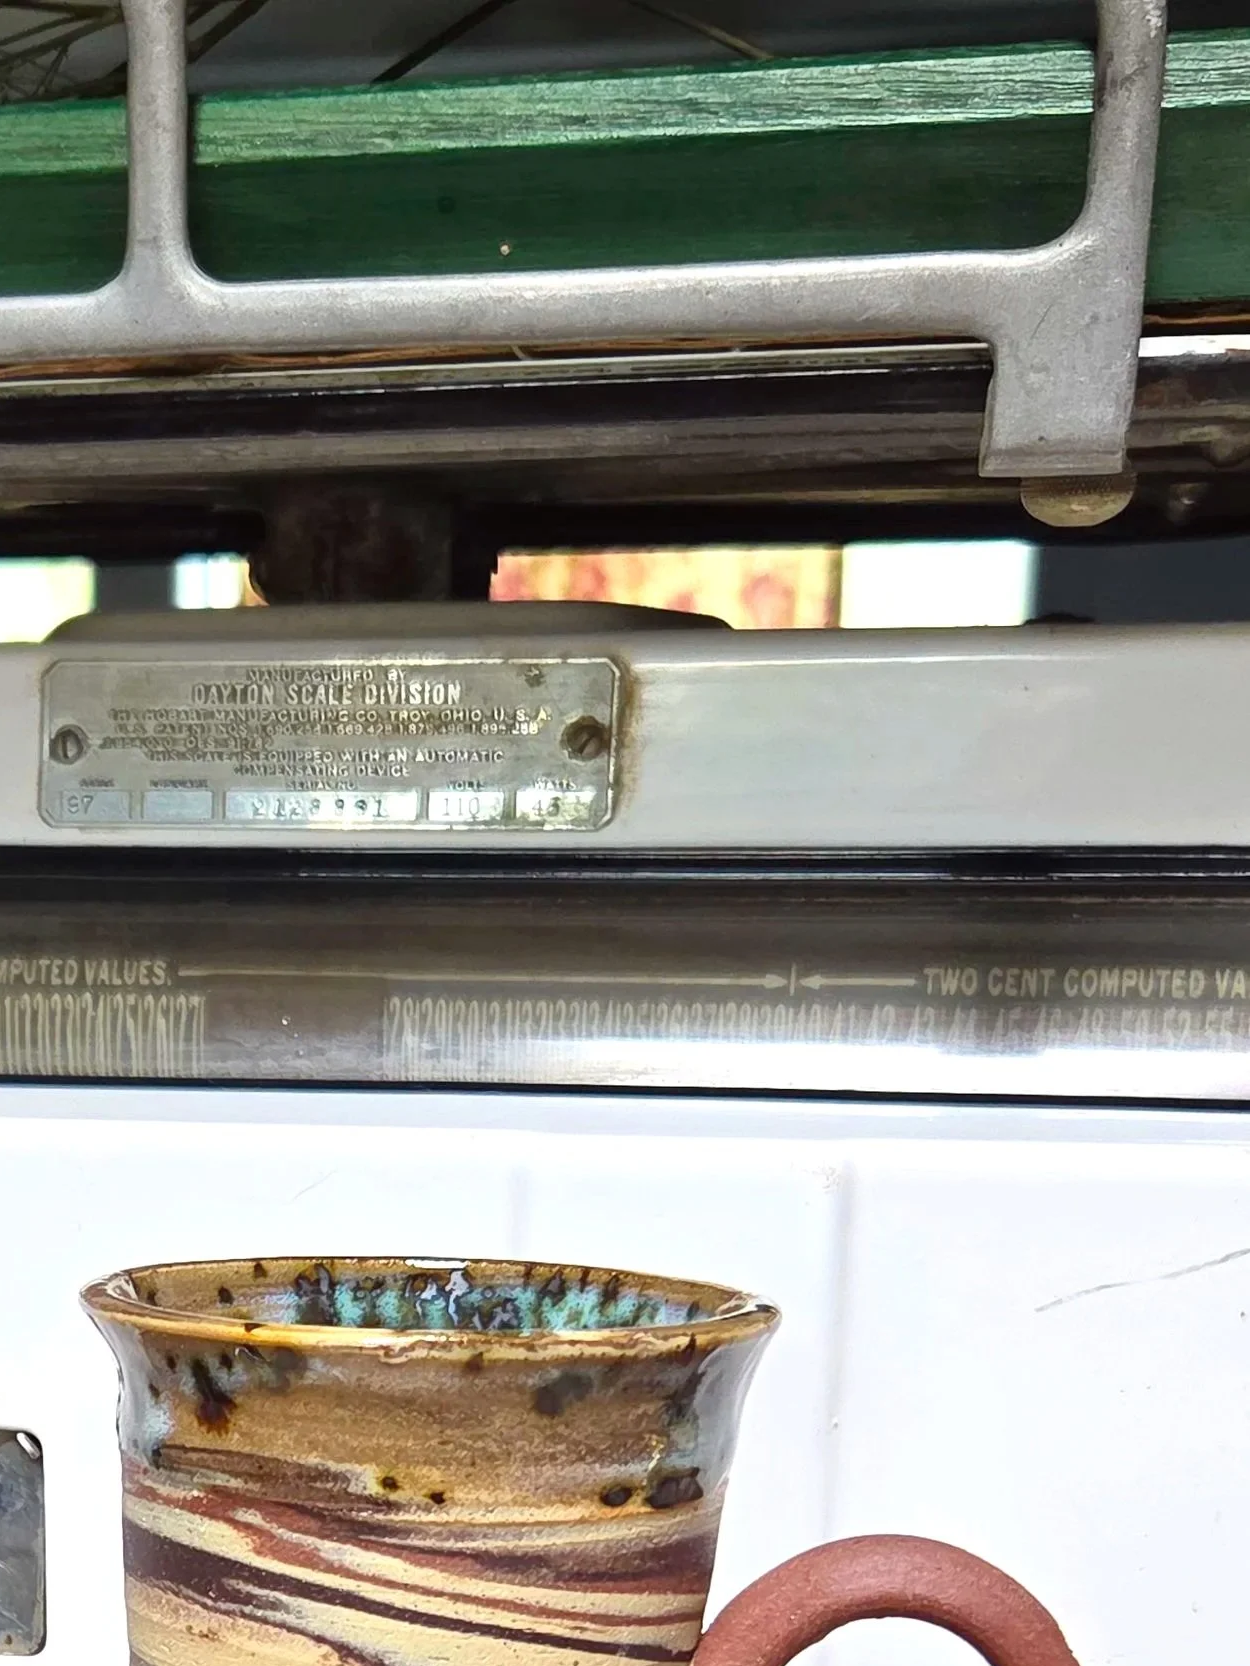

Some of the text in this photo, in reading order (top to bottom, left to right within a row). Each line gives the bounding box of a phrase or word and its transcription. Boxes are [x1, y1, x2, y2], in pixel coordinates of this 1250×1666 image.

[388, 669, 407, 682] BY
[194, 683, 461, 705] DAYTON SCALE DIVISION
[214, 709, 349, 722] MANUFACTURING
[186, 750, 232, 762] SCALE
[259, 750, 333, 763] EQUIPPED
[340, 750, 380, 763] WITH
[388, 751, 407, 762] AN
[415, 750, 505, 763] AUTOMATIC
[233, 764, 411, 777] COMPENSATING DEVICE
[84, 959, 173, 987] VALUES.
[924, 967, 978, 997] TWO
[987, 968, 1054, 998] CENT
[1062, 968, 1205, 999] COMPUTED
